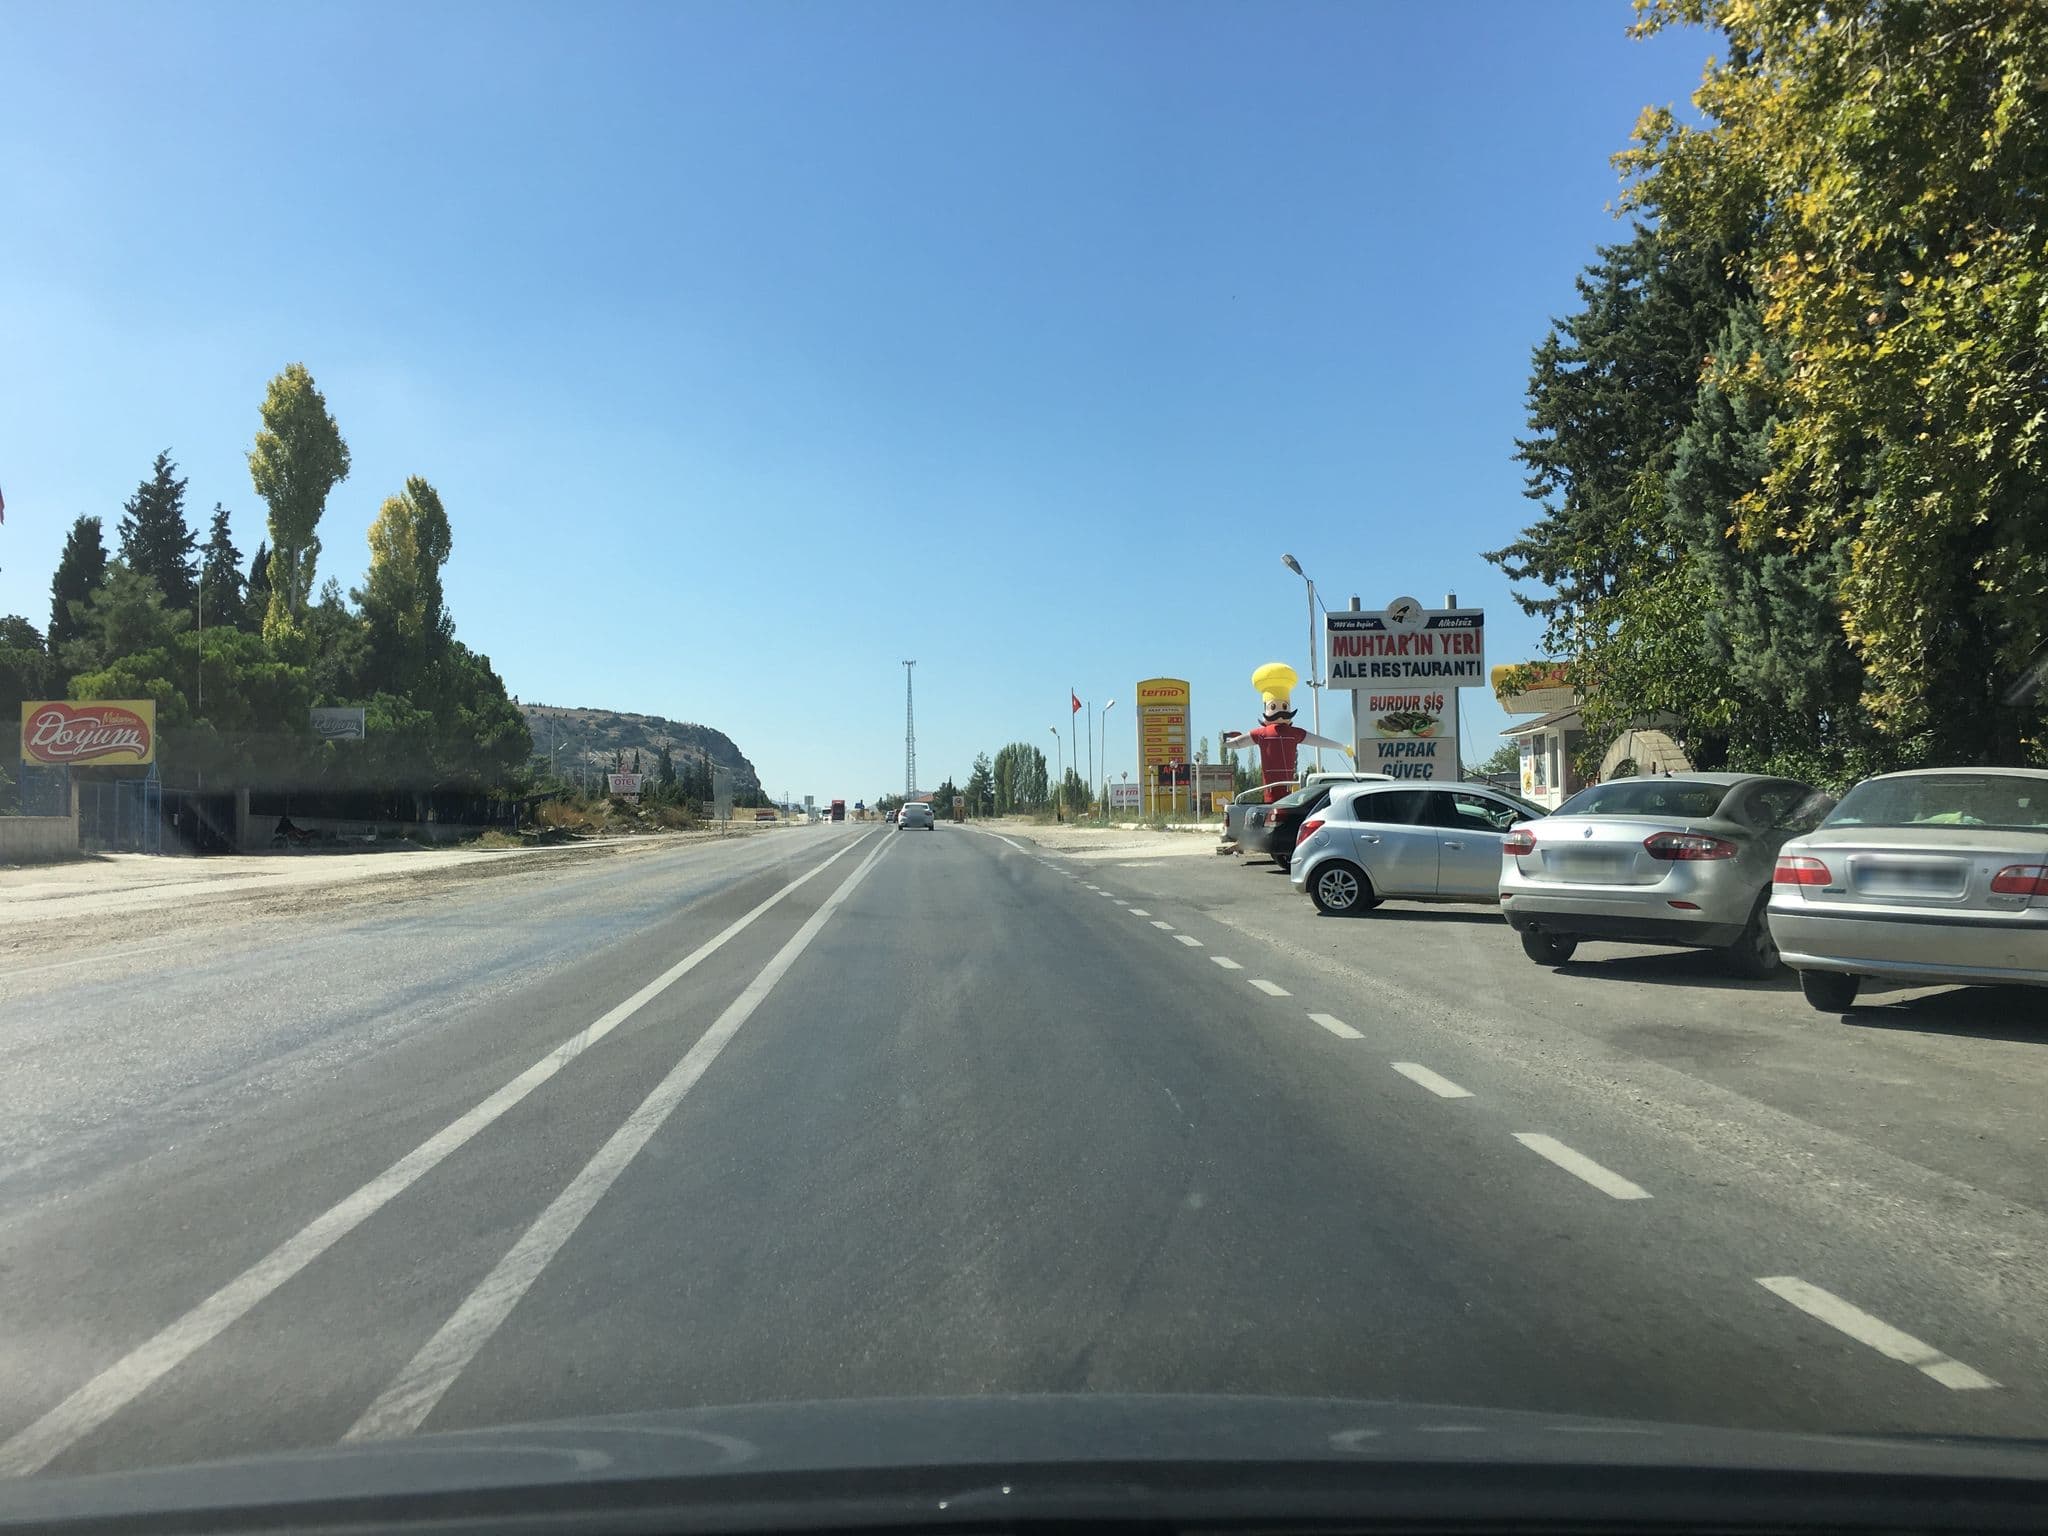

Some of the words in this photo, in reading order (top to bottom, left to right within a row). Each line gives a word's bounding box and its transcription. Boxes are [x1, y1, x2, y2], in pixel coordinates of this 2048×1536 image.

[1438, 617, 1472, 627] Alkolsüz
[1333, 633, 1433, 657] MUHTAR'IN
[1440, 629, 1480, 655] YERİ
[1332, 660, 1367, 678] AİLE
[1371, 660, 1481, 678] RESTAURANTI
[1141, 687, 1179, 697] termo
[1370, 695, 1421, 711] BURDUR
[1423, 691, 1444, 714] ŞİŞ
[31, 711, 145, 755] Doyum
[1377, 742, 1437, 758] YAPRAK
[1382, 760, 1434, 781] GÜVEÇ
[615, 778, 637, 786] OTEL
